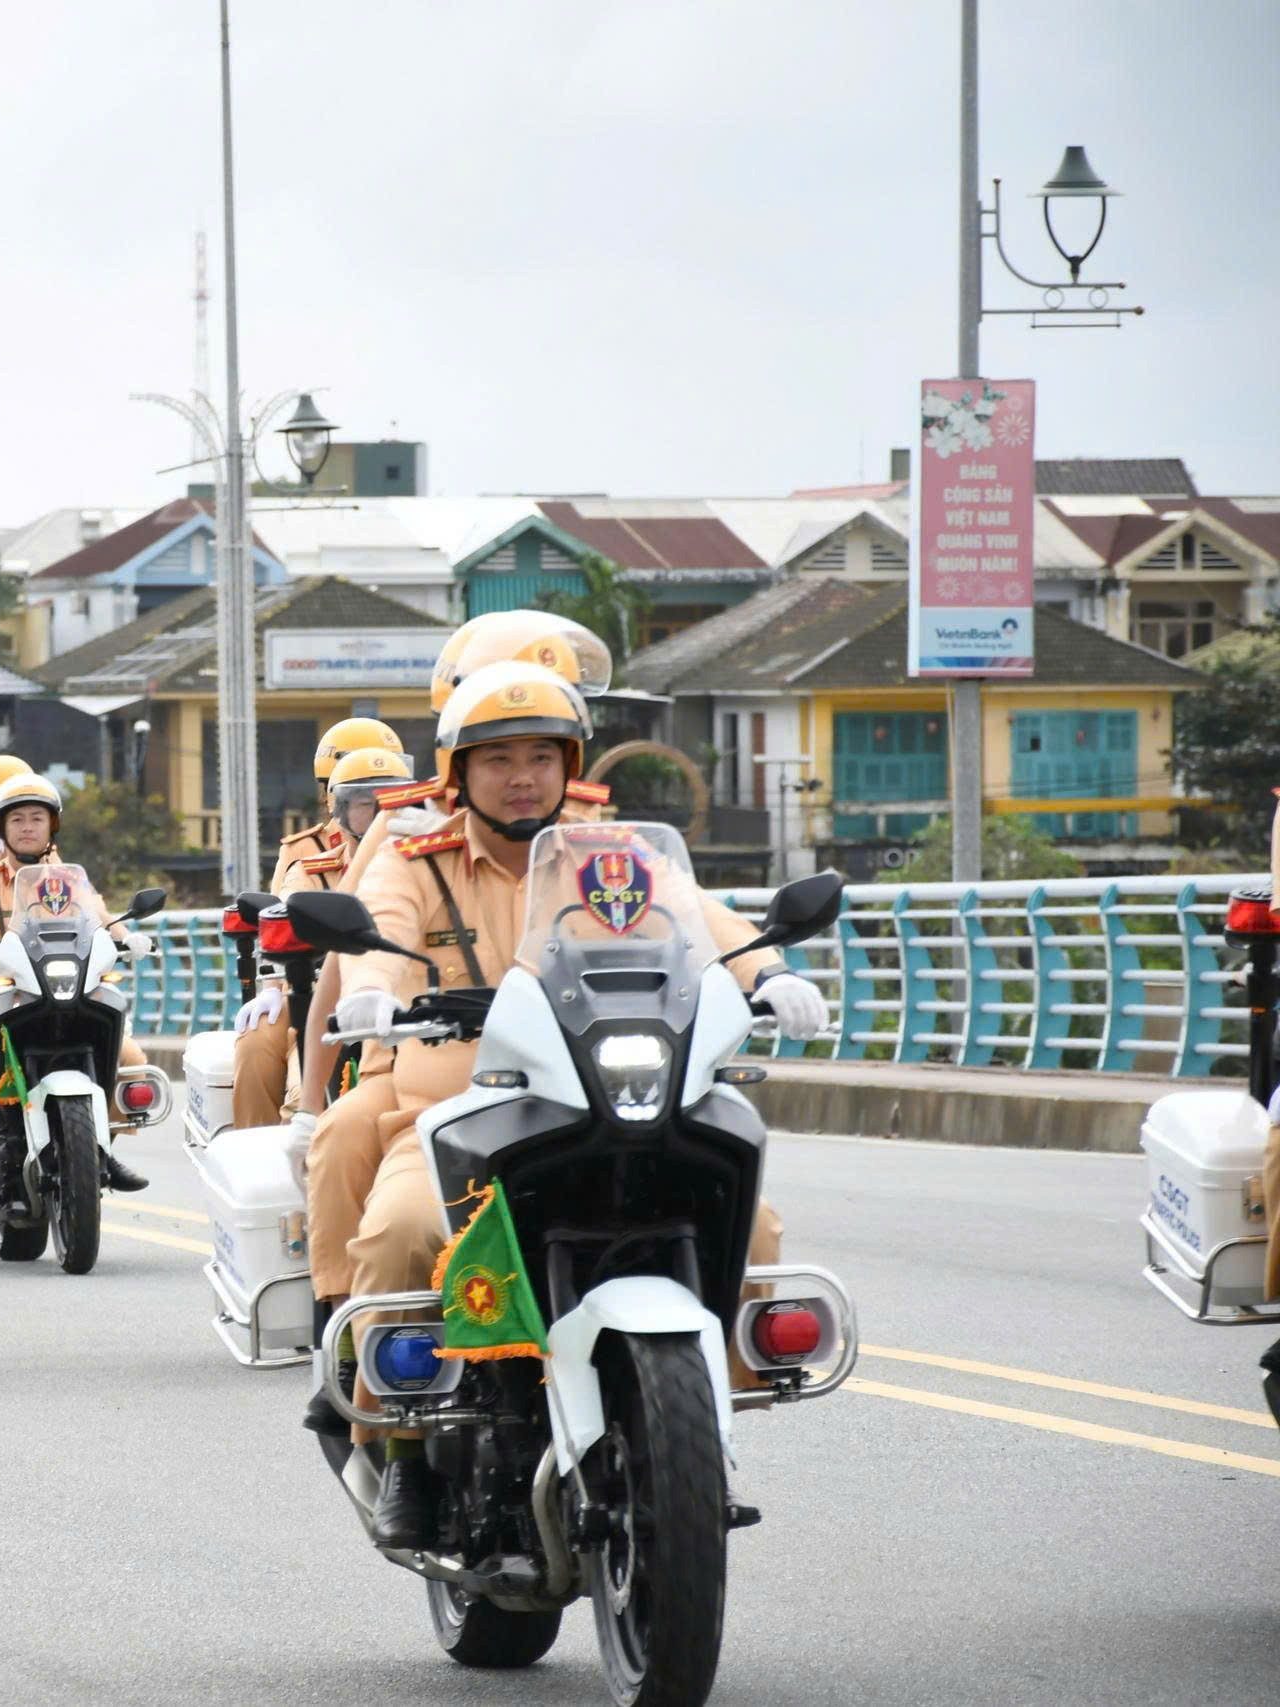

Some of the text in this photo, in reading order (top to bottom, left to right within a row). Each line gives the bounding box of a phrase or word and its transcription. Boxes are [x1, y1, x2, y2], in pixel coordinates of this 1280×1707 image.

[977, 510, 1011, 526] NAM
[935, 628, 1001, 640] VietinBank
[589, 890, 645, 904] CSGT
